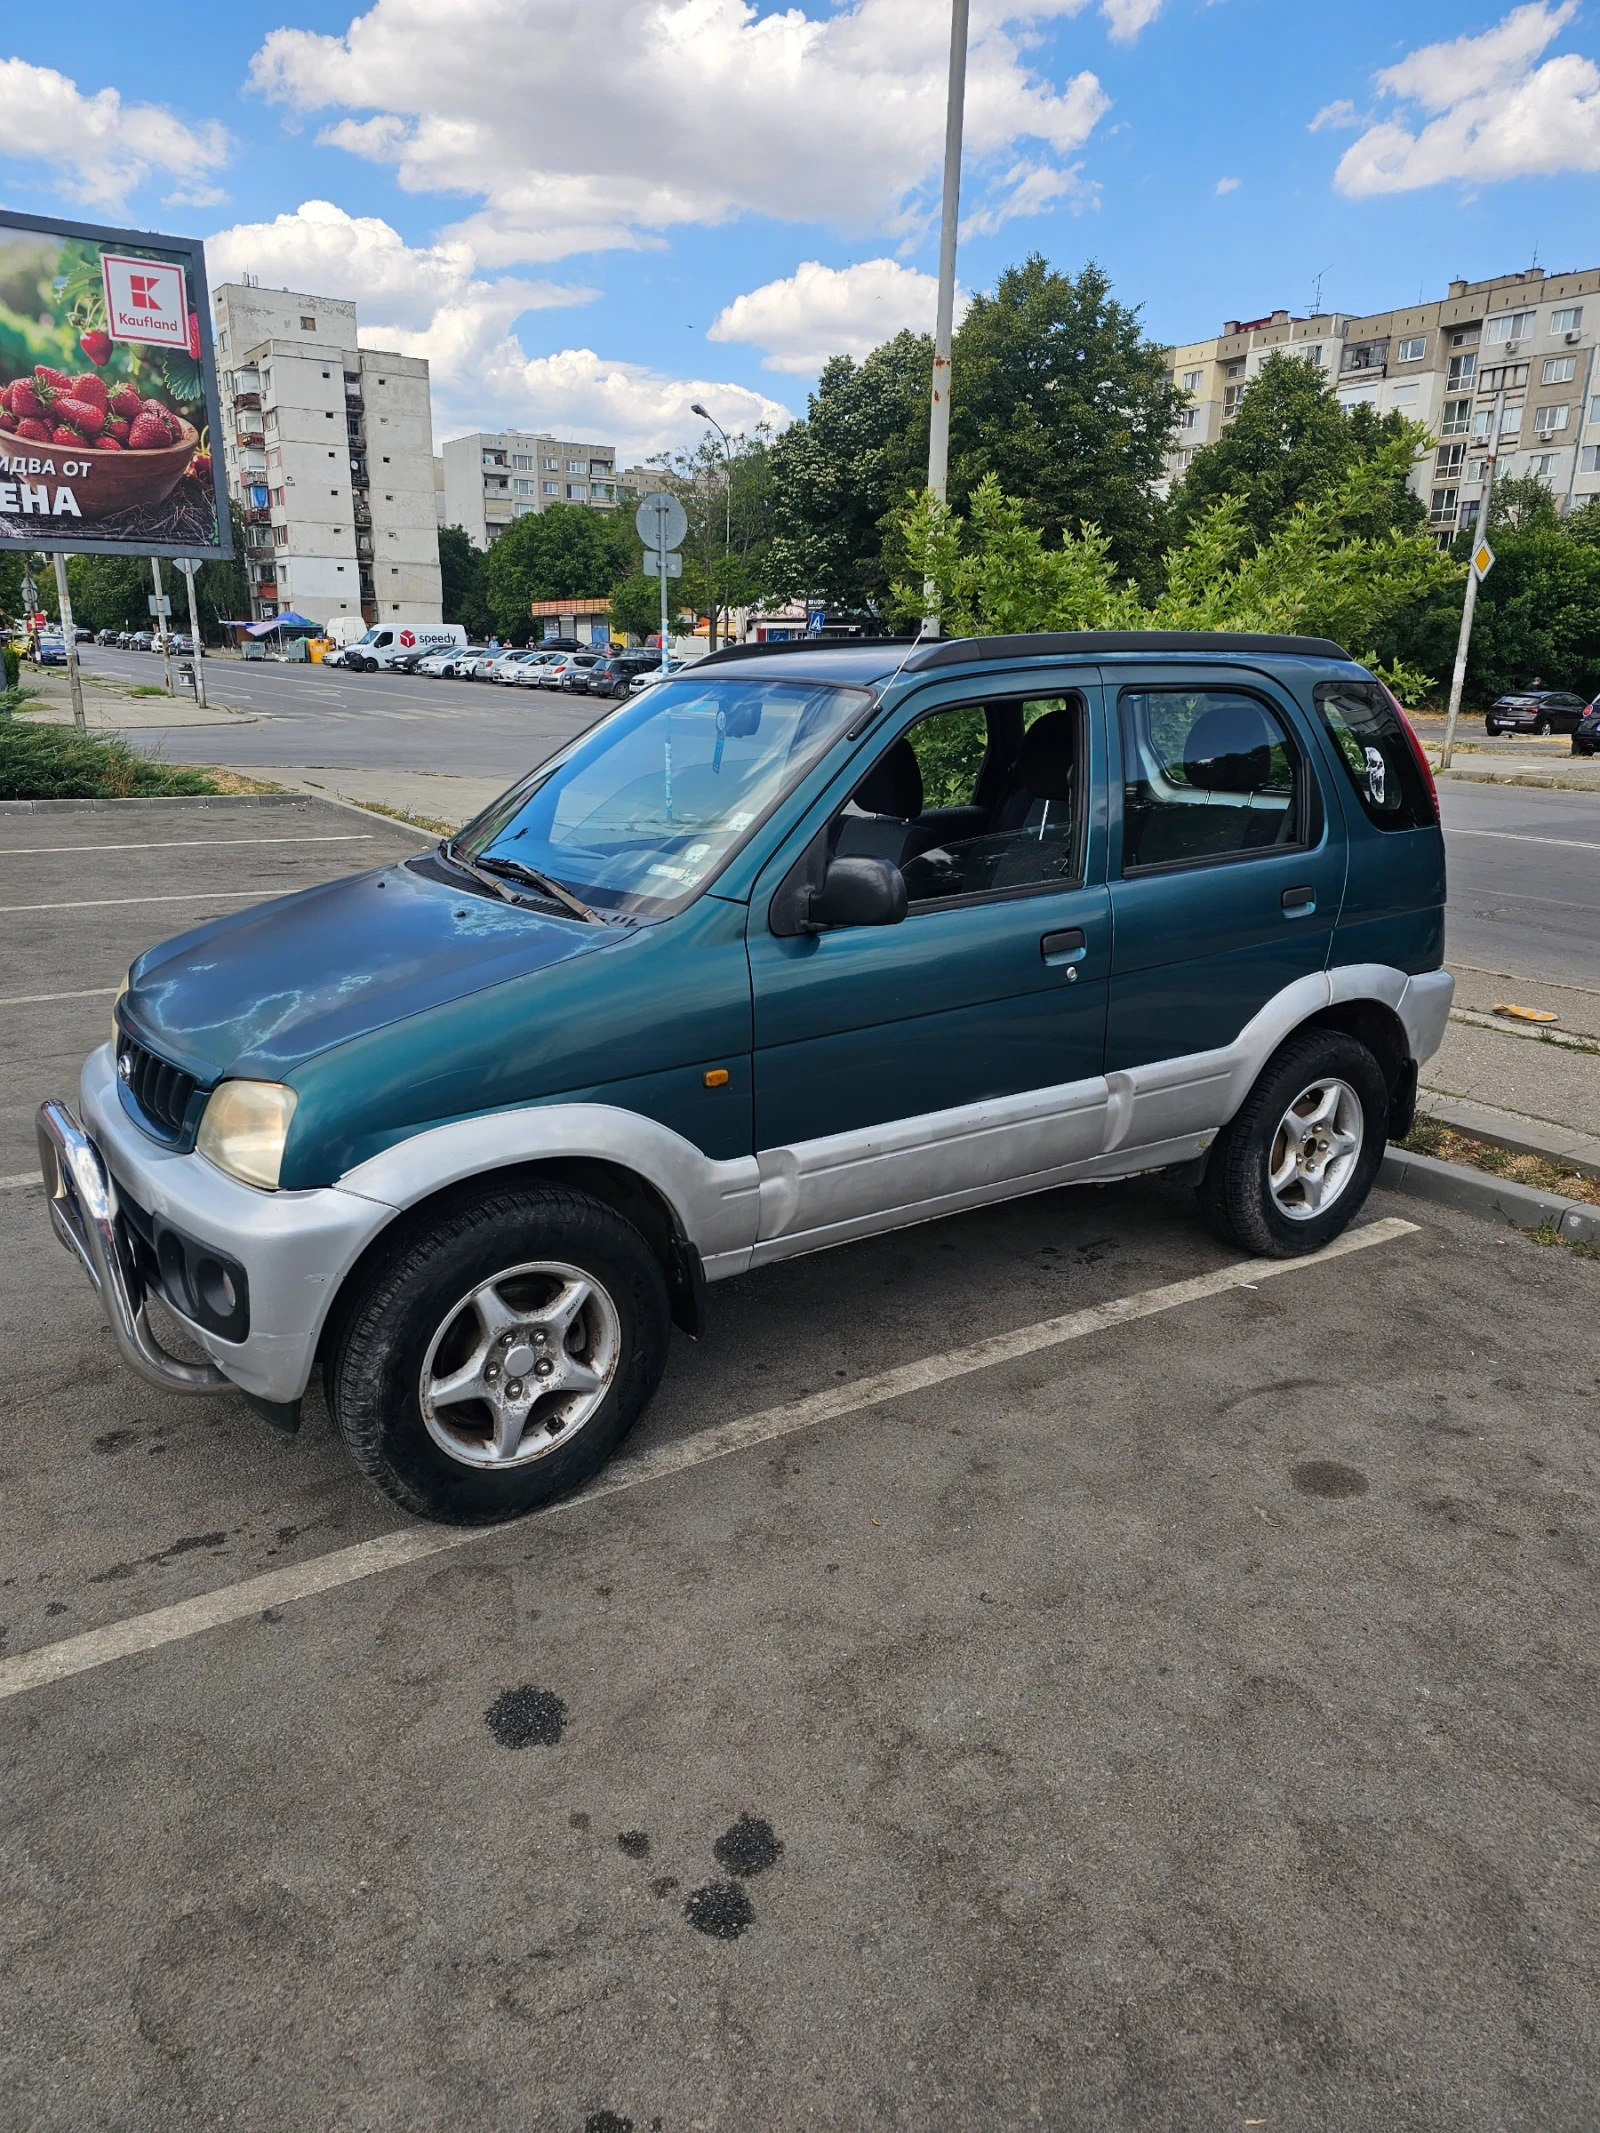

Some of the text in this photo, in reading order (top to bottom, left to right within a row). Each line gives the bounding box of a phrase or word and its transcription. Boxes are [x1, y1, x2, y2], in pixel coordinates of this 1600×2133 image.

[119, 312, 178, 331] Kaufland
[62, 460, 92, 477] ОТ
[0, 482, 82, 517] ЕНА
[419, 632, 456, 645] speedy
